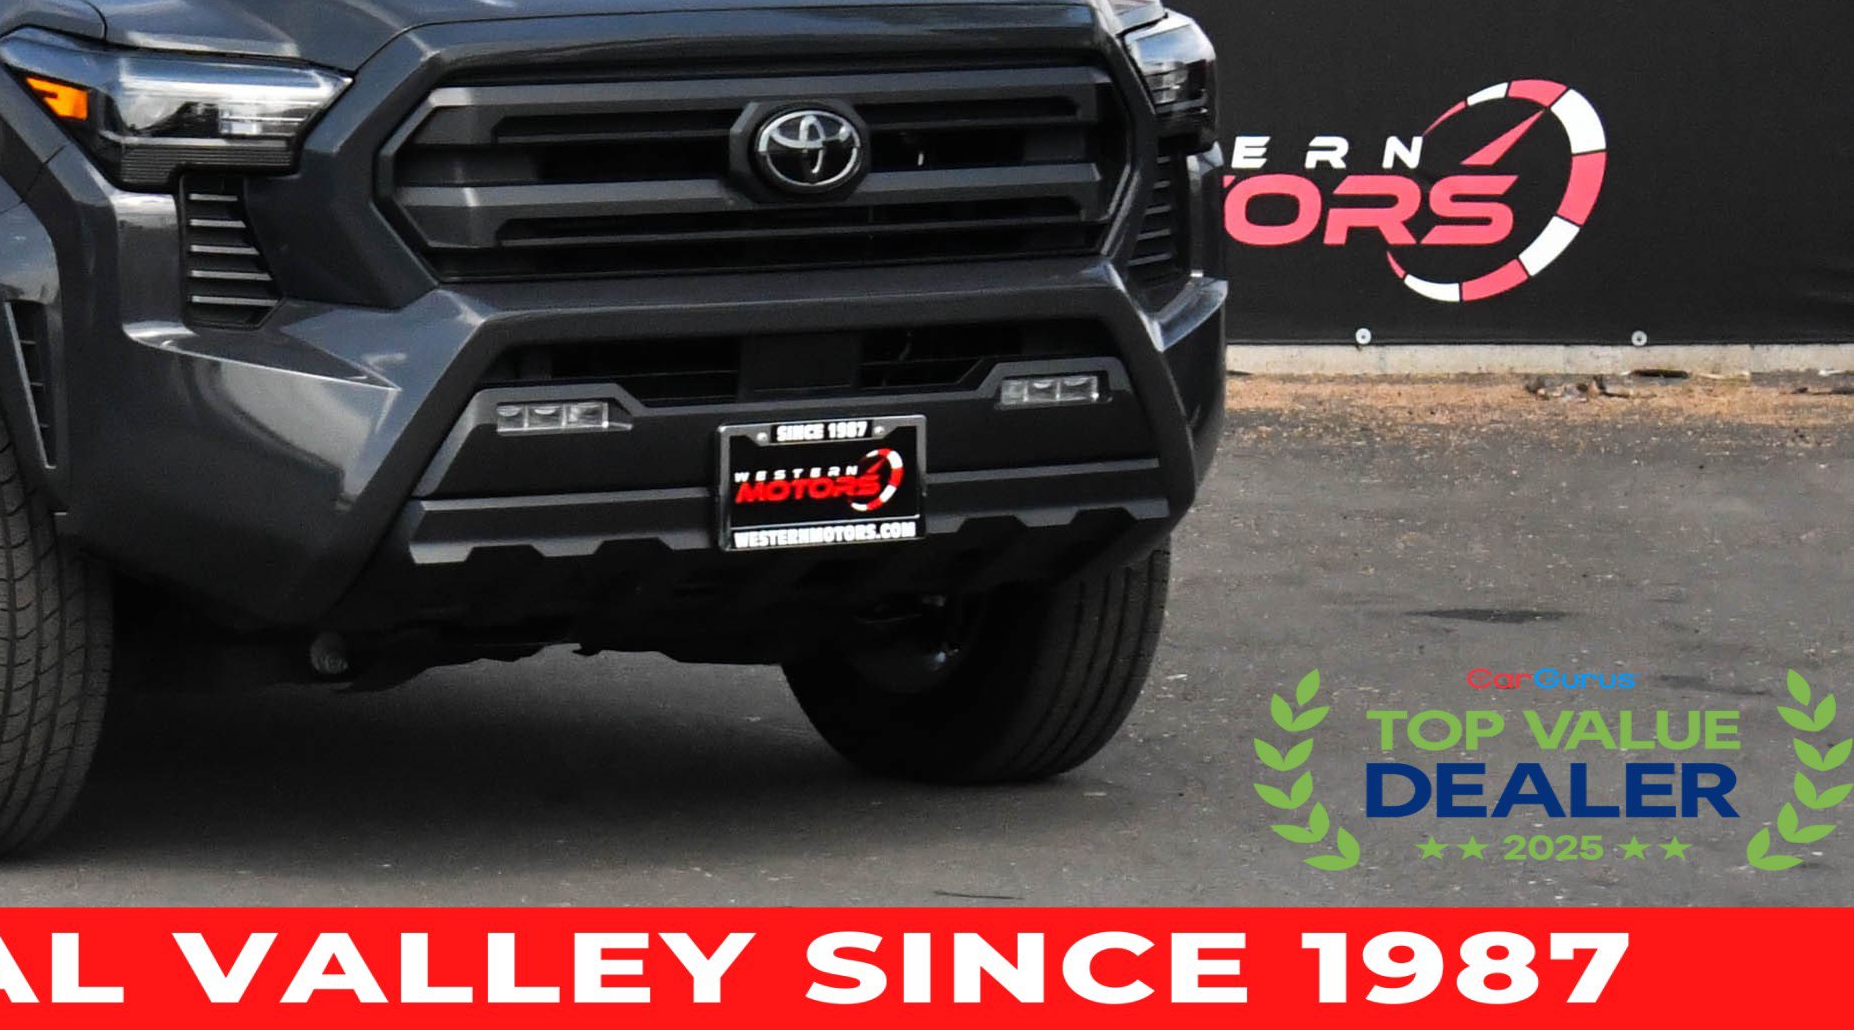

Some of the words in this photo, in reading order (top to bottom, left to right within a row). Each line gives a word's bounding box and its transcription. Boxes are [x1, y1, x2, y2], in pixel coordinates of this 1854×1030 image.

[1224, 174, 1517, 245] ORS
[777, 423, 824, 442] SINCE
[734, 466, 858, 482] WESTERN
[735, 473, 881, 503] MOTORS
[734, 522, 916, 548] WESTERNMOTORS.COM
